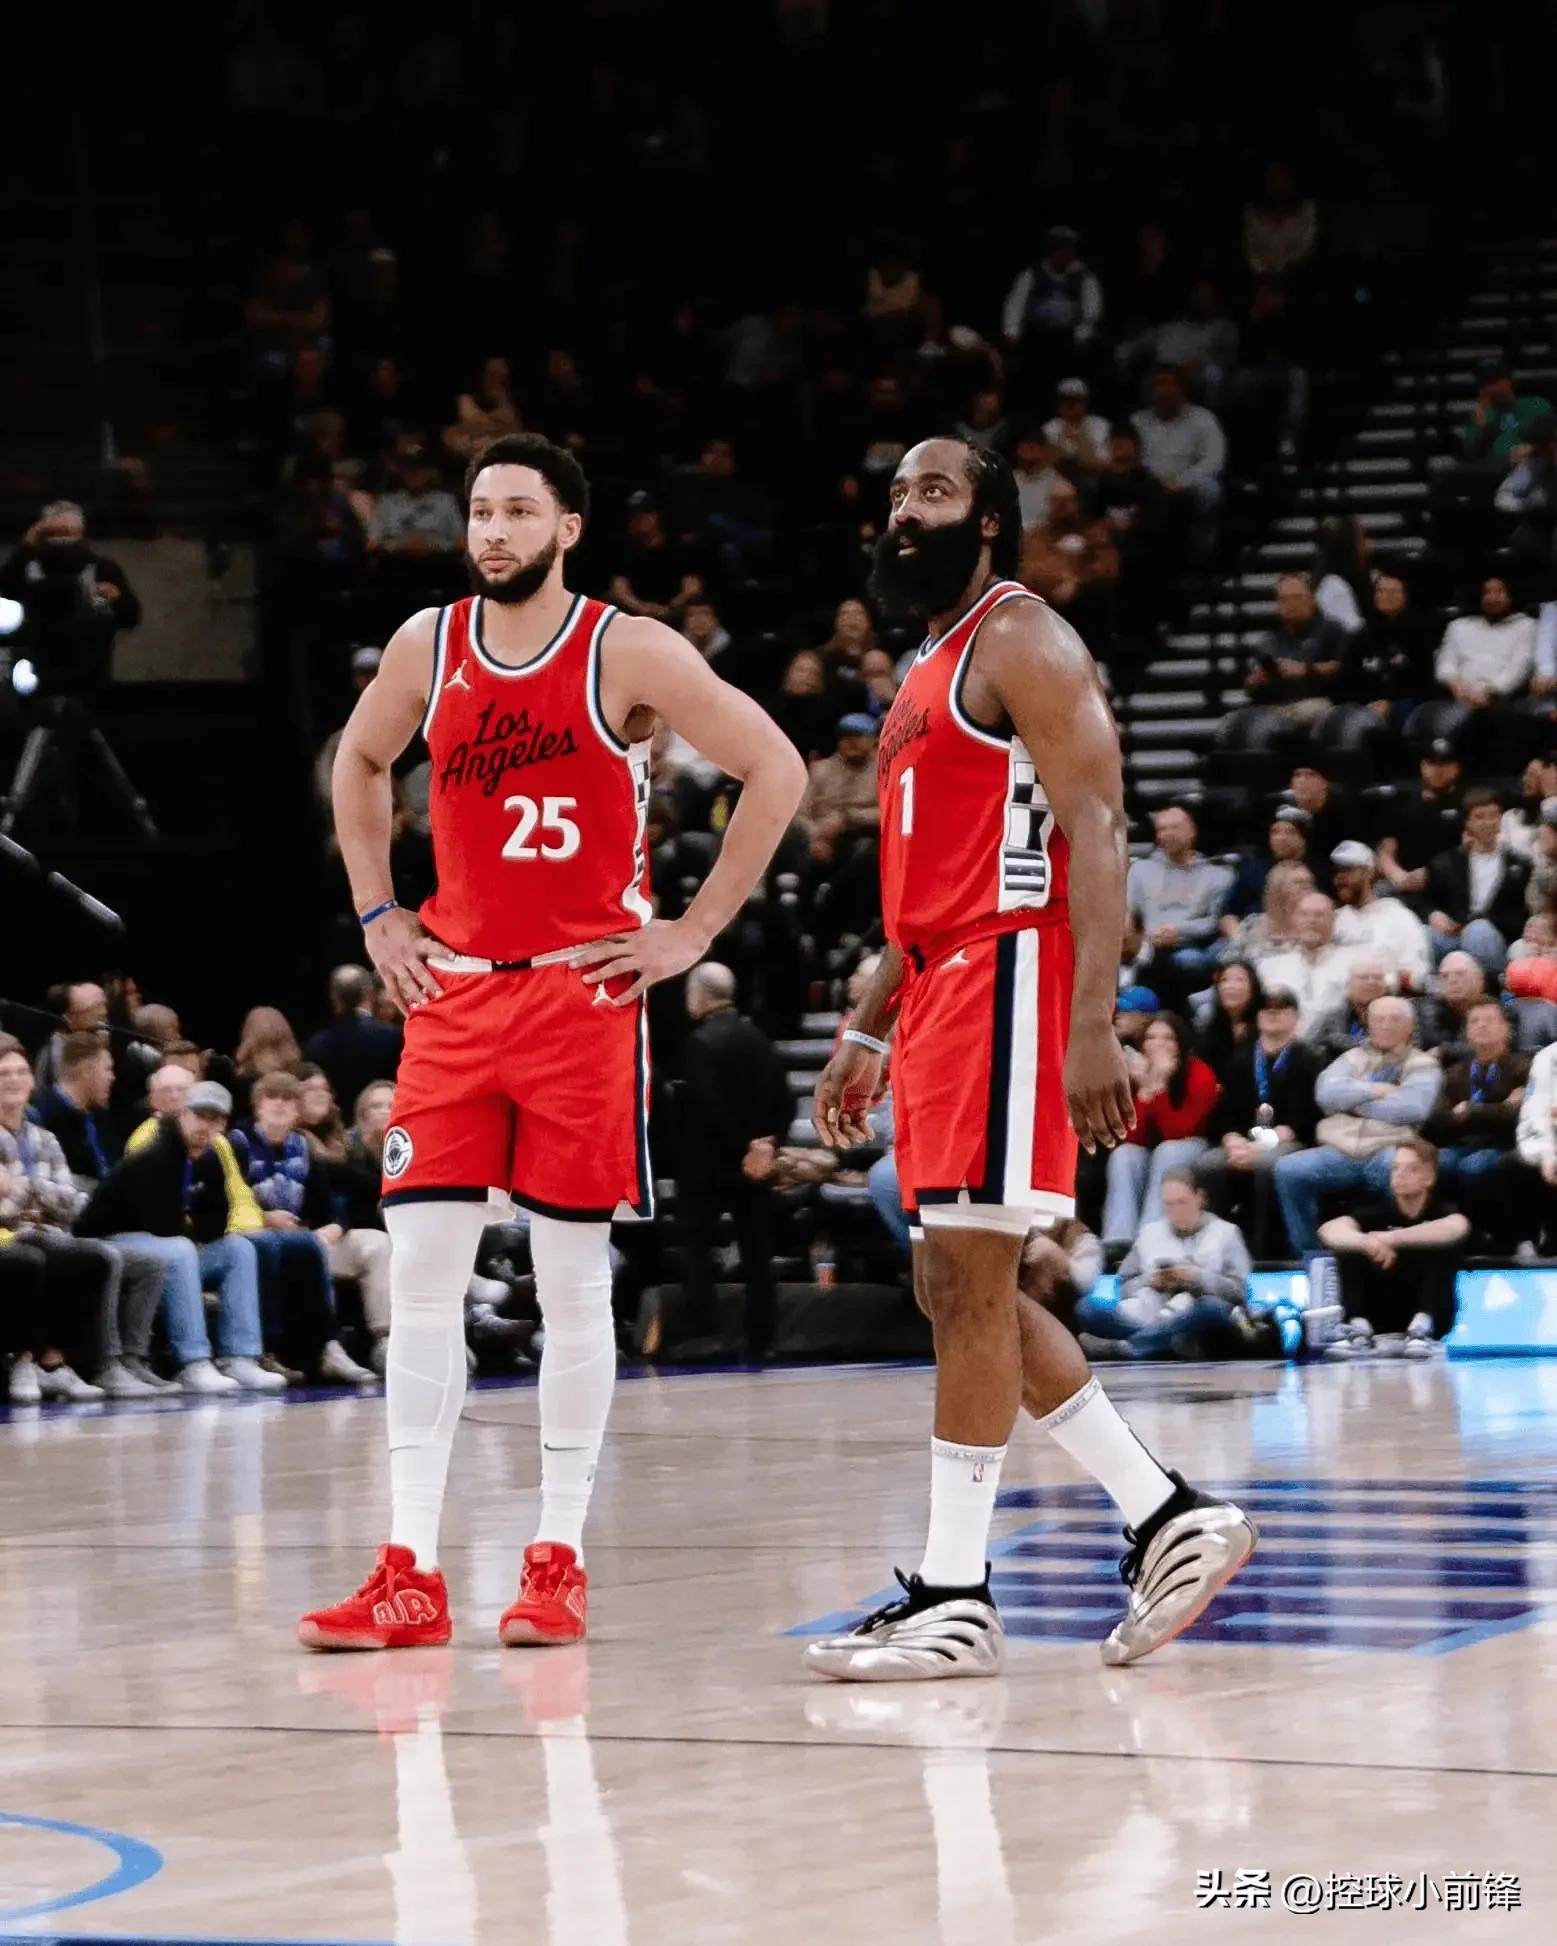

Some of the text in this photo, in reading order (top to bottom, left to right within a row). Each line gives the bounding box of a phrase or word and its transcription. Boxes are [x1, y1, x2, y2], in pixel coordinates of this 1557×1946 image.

[473, 699, 531, 747] Los
[439, 722, 580, 798] Angeles
[501, 794, 582, 859] 25
[899, 766, 915, 835] 1
